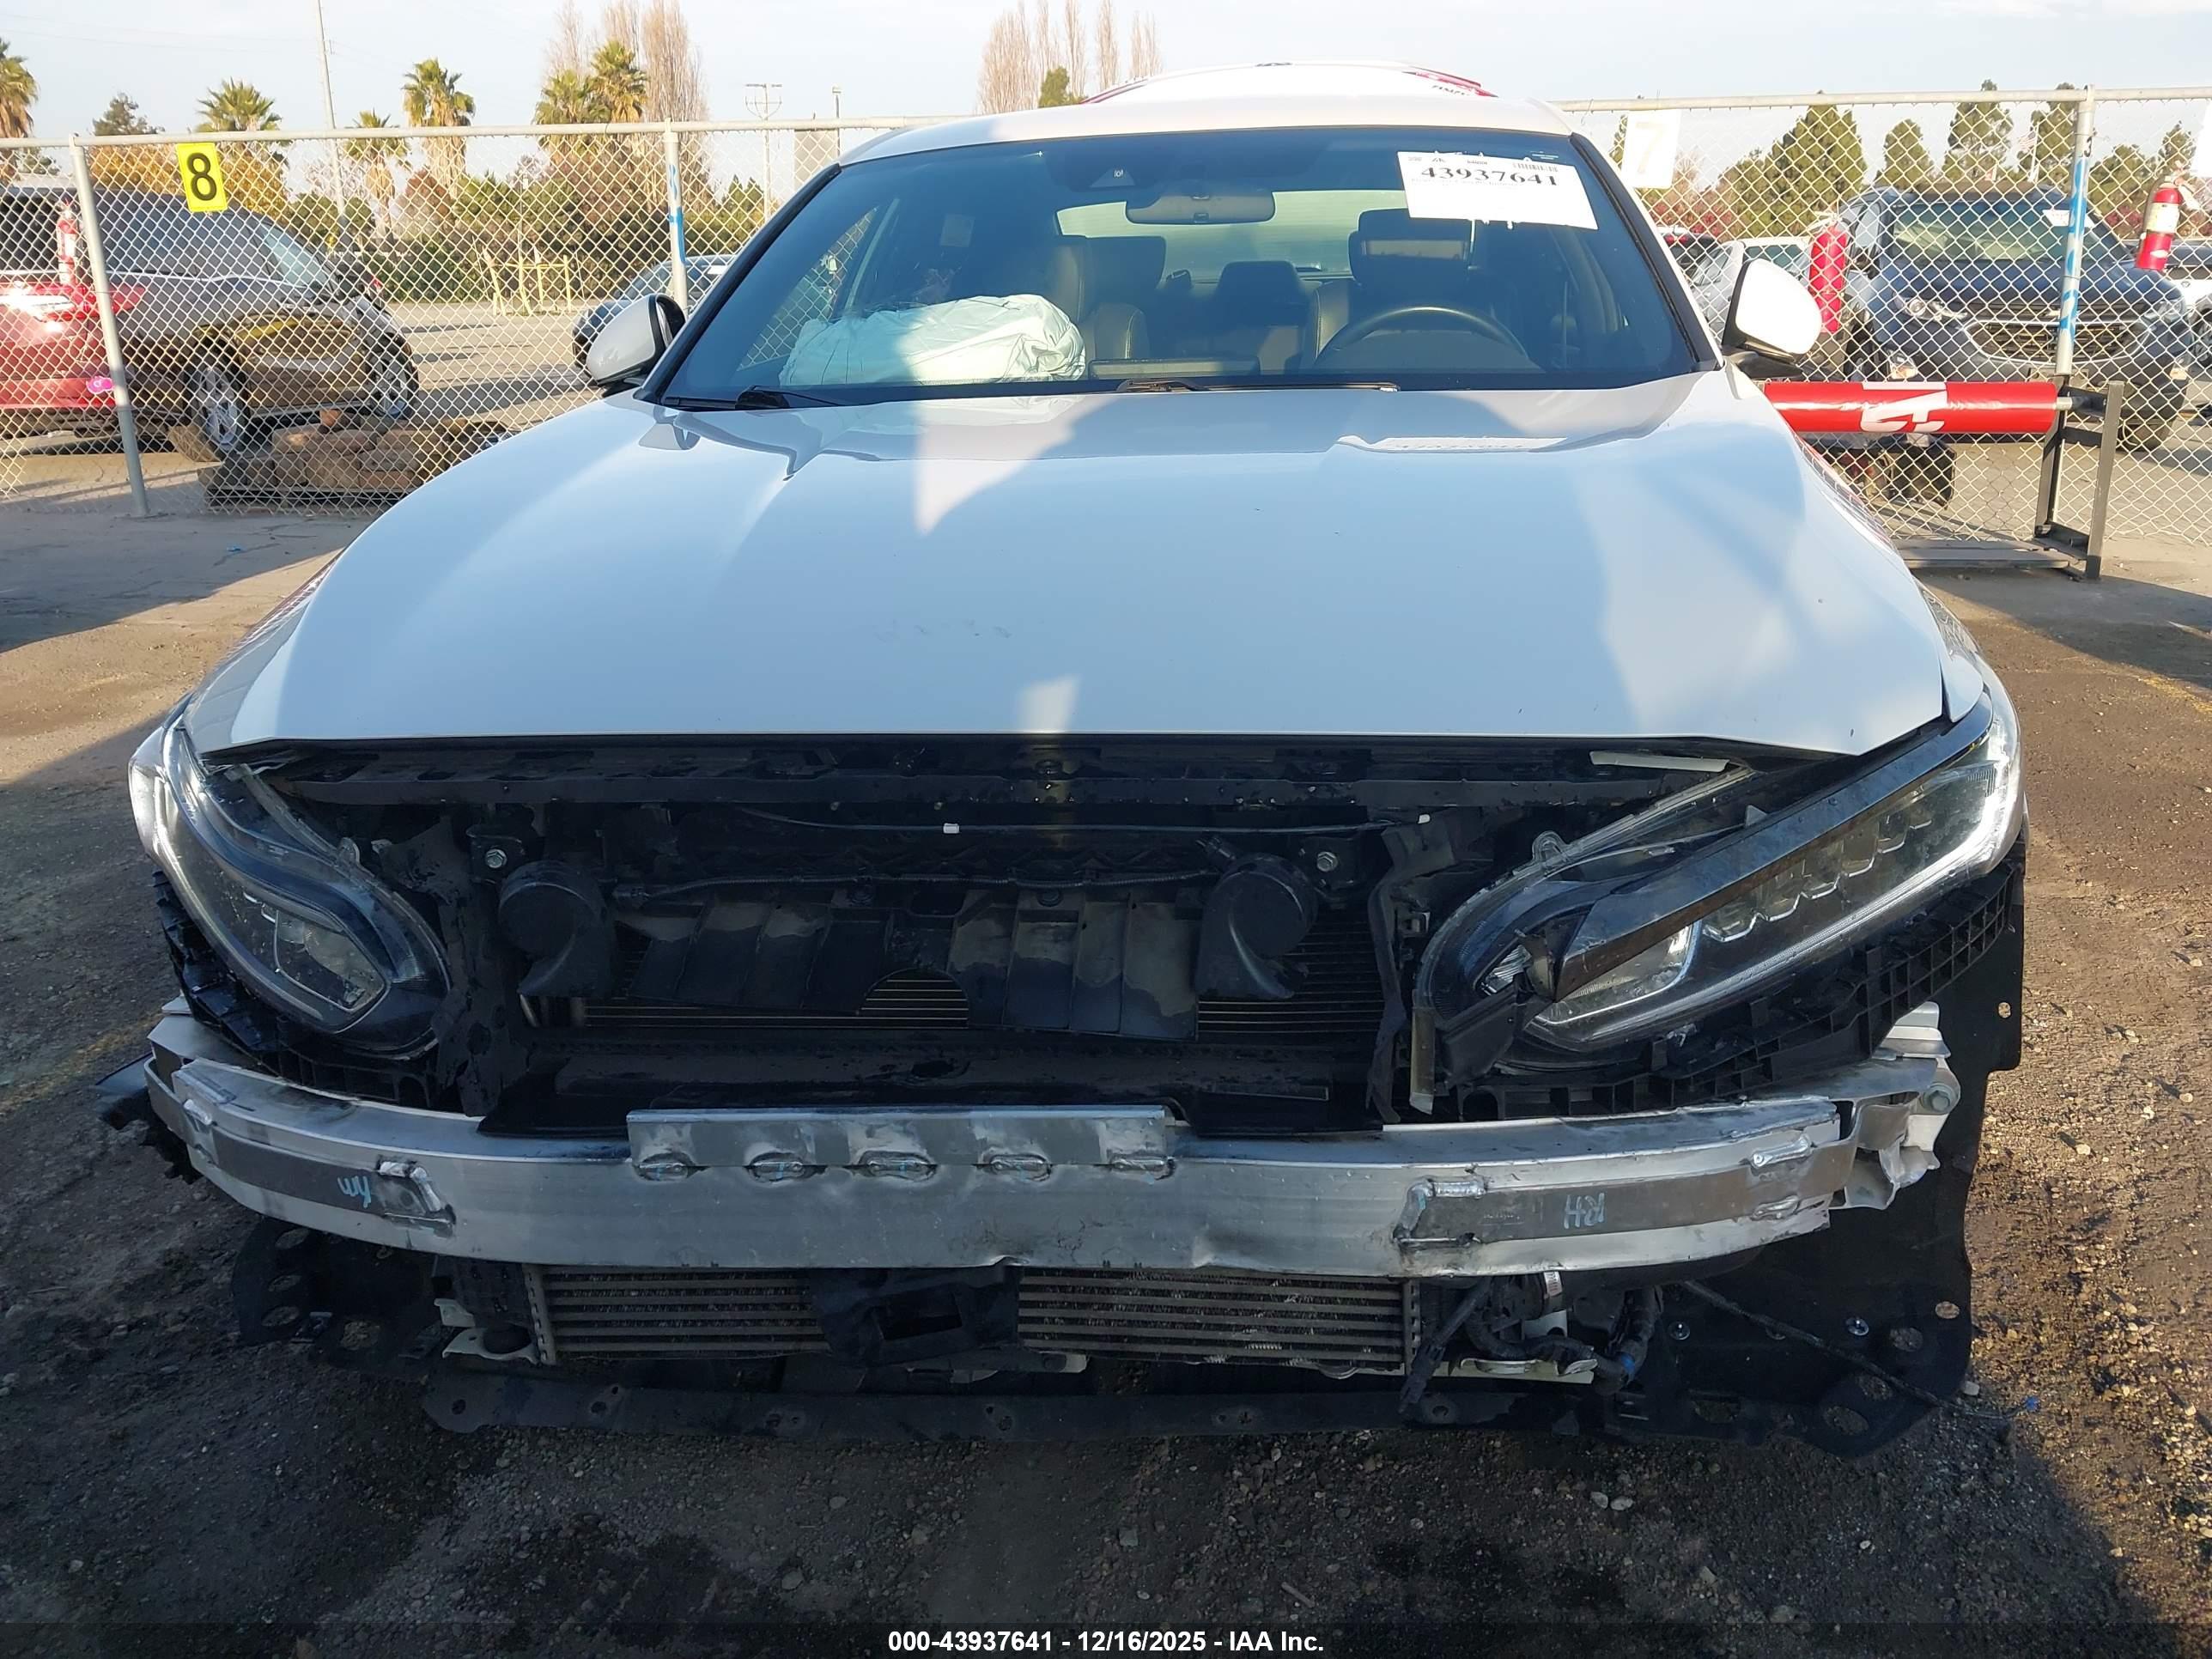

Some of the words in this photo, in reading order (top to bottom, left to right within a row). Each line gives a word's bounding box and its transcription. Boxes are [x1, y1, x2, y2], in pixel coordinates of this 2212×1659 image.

[1635, 121, 1664, 174] 7
[186, 152, 217, 201] 8
[1421, 167, 1557, 186] 43937641
